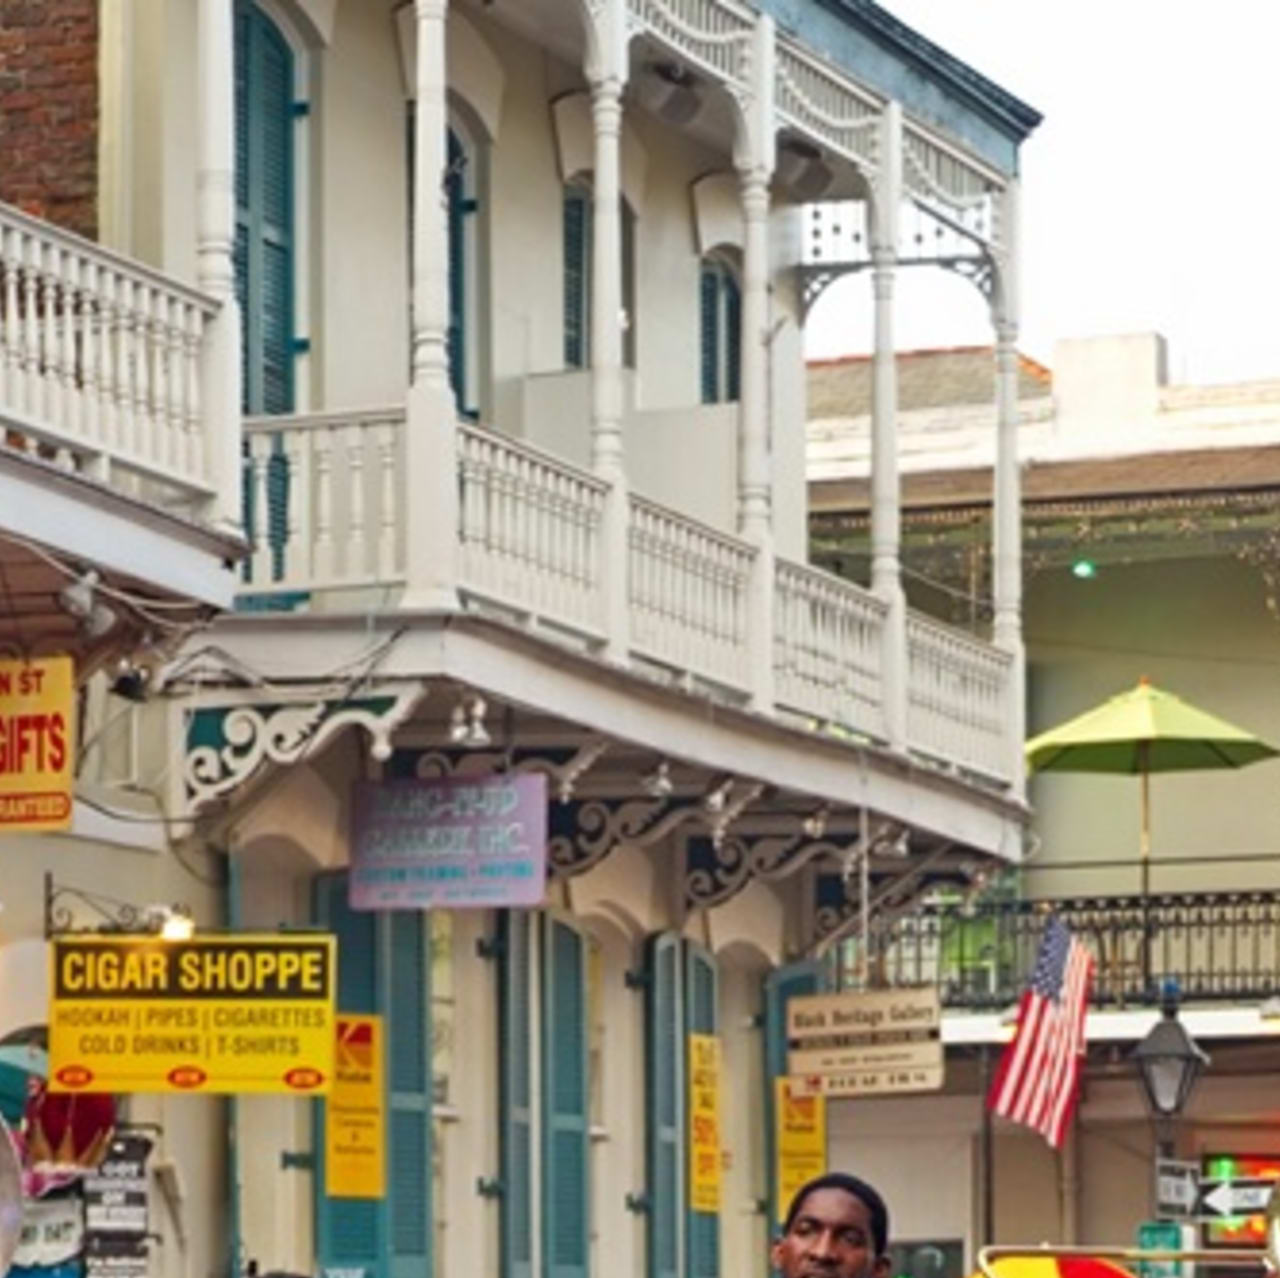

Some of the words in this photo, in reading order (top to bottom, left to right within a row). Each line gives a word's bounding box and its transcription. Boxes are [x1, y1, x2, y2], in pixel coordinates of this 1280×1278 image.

[18, 668, 45, 696] ST
[62, 951, 169, 991] CIGAR
[177, 951, 323, 991] SHOPPE
[56, 1007, 131, 1028] HOOKAH
[146, 1007, 198, 1028] PIPES
[212, 1006, 326, 1028] CIGARETTES
[78, 1034, 126, 1055] COLD
[132, 1034, 199, 1055] DRINKS
[216, 1034, 300, 1056] T-SHIRTS
